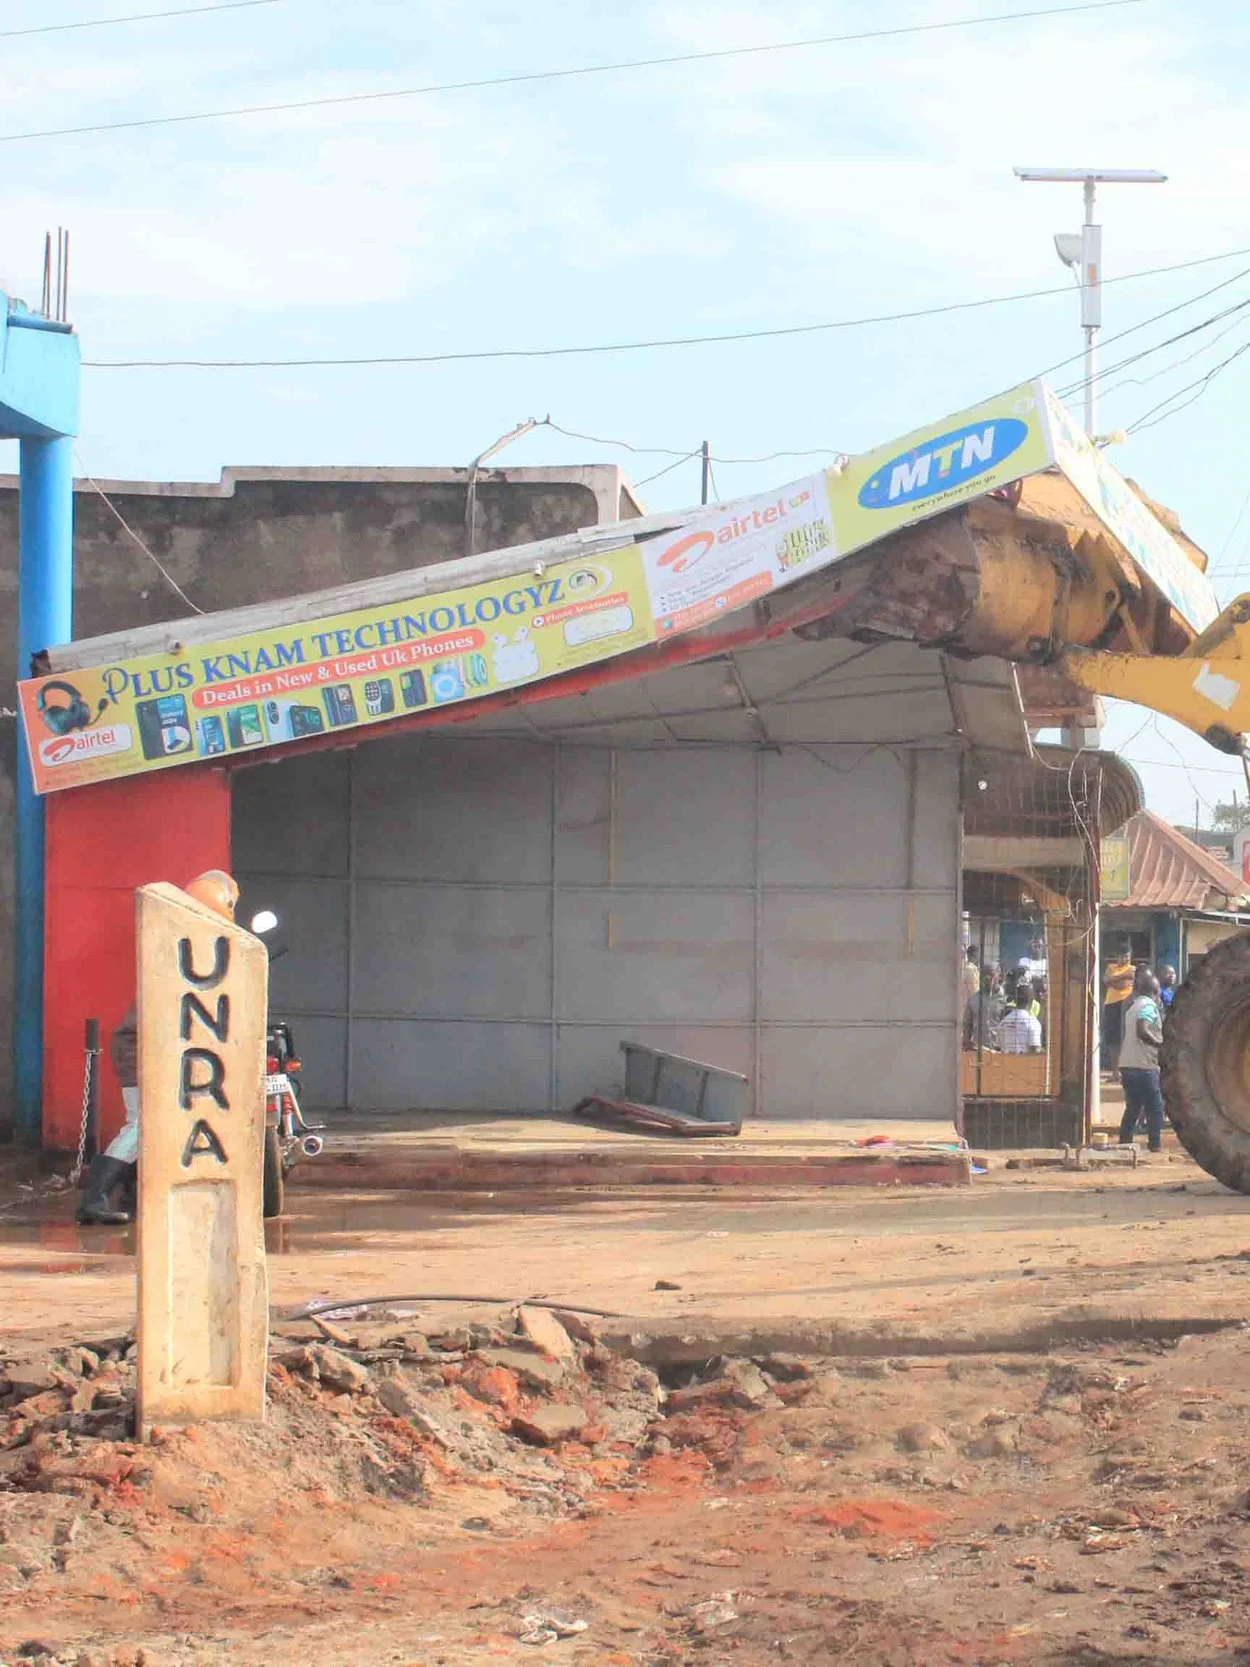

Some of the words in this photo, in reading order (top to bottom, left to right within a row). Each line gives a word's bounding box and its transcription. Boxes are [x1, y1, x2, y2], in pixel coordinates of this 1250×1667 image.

[888, 425, 995, 500] MTN
[716, 498, 788, 544] airtel
[912, 486, 963, 512] everywhere
[102, 662, 194, 704] PLUS
[201, 639, 306, 684] KNAM
[312, 578, 566, 657] TECHNOLOGYZ
[202, 681, 251, 705] Deals
[254, 680, 272, 694] in
[276, 672, 312, 690] New
[317, 663, 331, 680] &
[335, 654, 378, 675] Used
[382, 647, 408, 667] Uk
[411, 636, 474, 661] Phones
[76, 730, 115, 750] airtel
[177, 936, 231, 1168] UNRA
